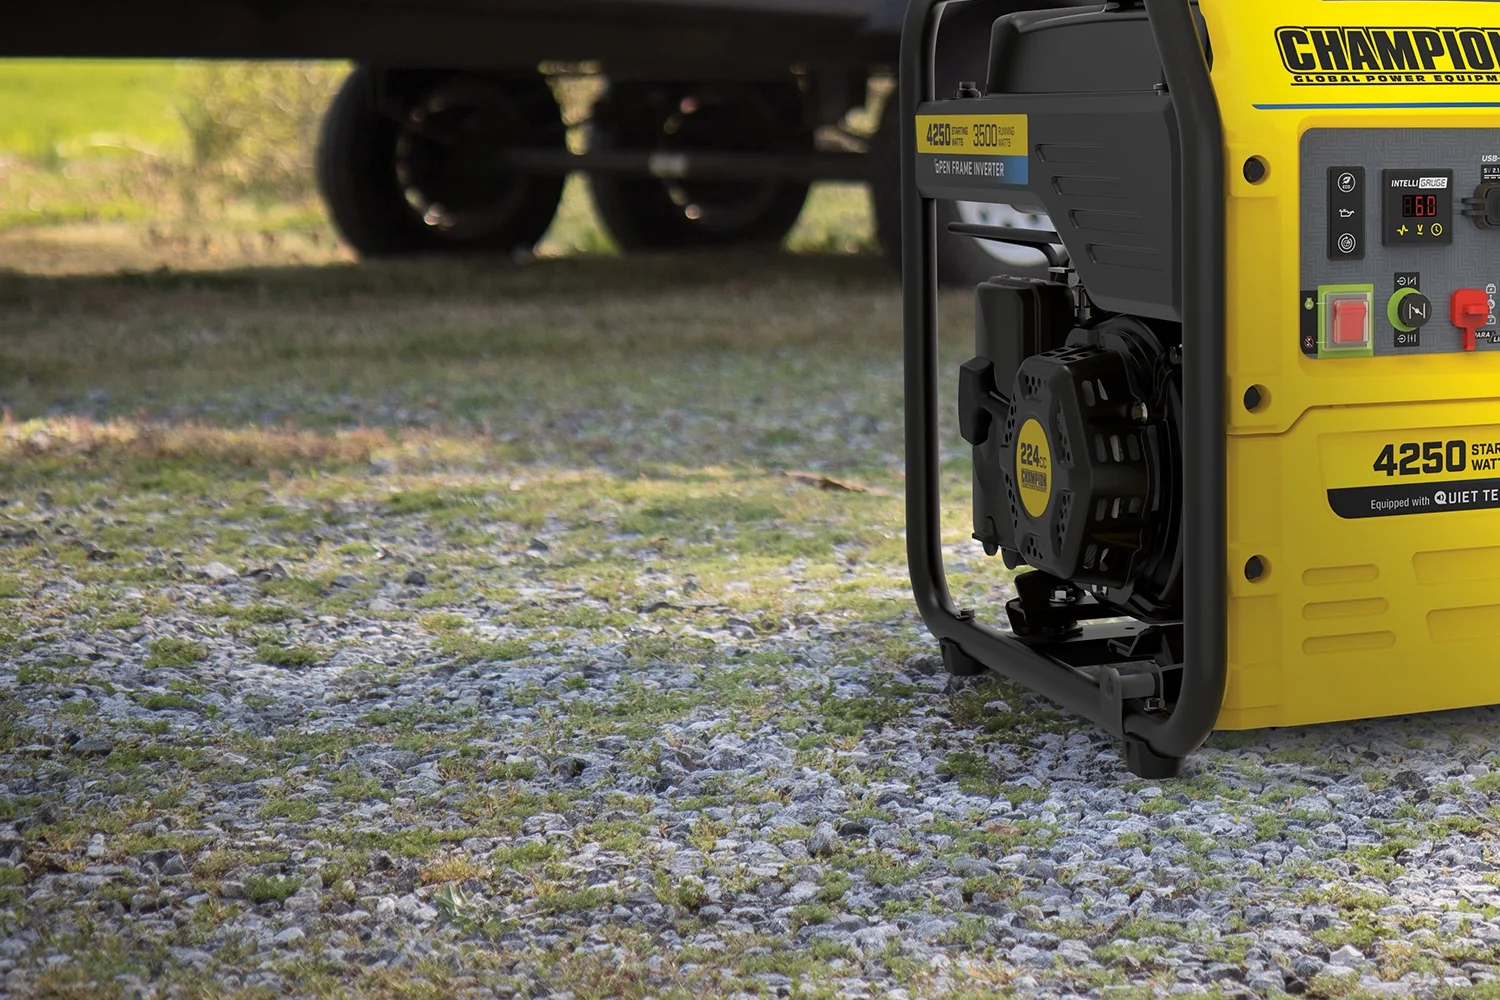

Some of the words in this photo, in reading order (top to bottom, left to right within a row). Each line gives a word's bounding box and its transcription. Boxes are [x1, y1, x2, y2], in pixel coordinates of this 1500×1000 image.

[1293, 75, 1361, 83] GLOBAL
[1365, 74, 1426, 82] POWER
[926, 123, 951, 146] 4250
[973, 124, 998, 147] 3500
[951, 126, 969, 136] STARTING
[951, 137, 964, 147] WATTS
[934, 159, 951, 175] OPEN
[951, 161, 973, 176] FRAME
[973, 162, 1005, 177] INVERTER
[1415, 195, 1436, 217] 60
[1373, 440, 1467, 476] 4250
[1370, 498, 1410, 511] Equipped
[1411, 496, 1430, 506] with
[1434, 490, 1479, 505] QUIET
